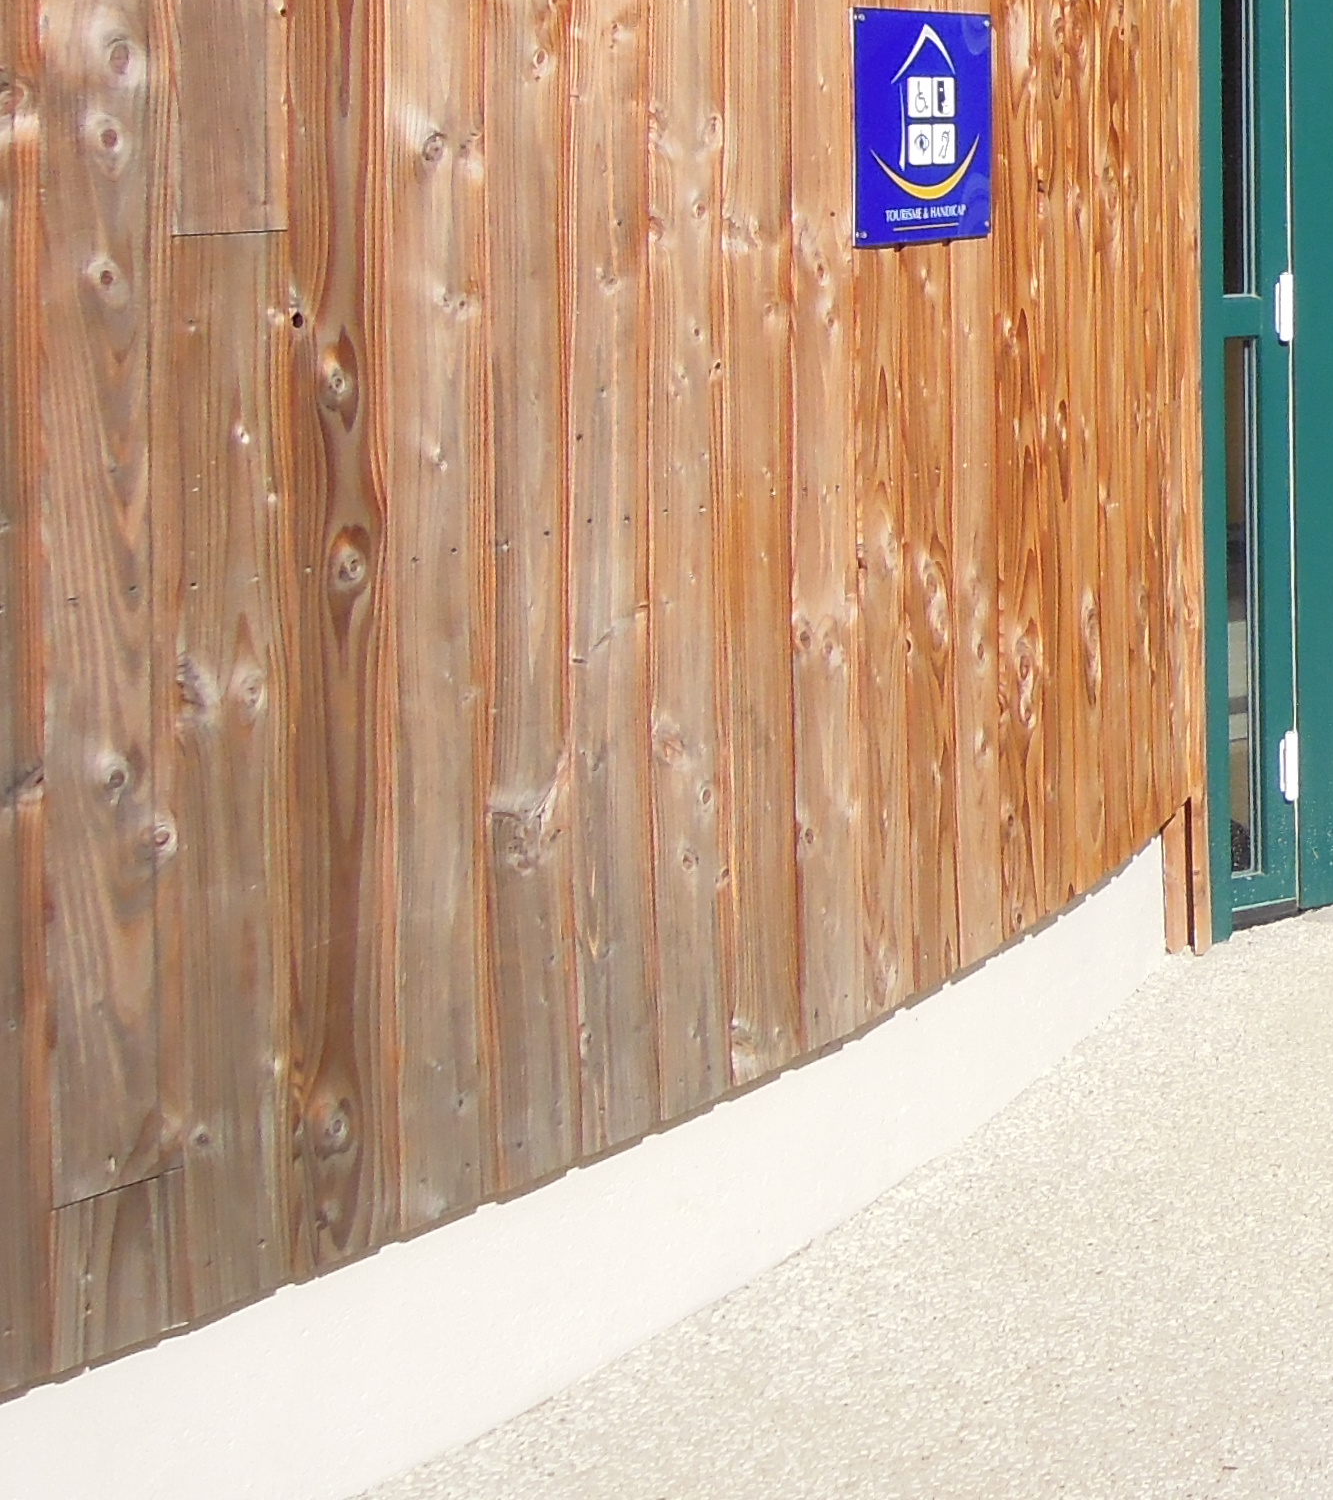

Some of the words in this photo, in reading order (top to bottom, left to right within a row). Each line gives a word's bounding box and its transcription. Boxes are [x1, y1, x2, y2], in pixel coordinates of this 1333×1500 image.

[885, 207, 922, 223] TOURISME
[923, 206, 929, 219] &
[930, 204, 967, 219] HANDICAP
